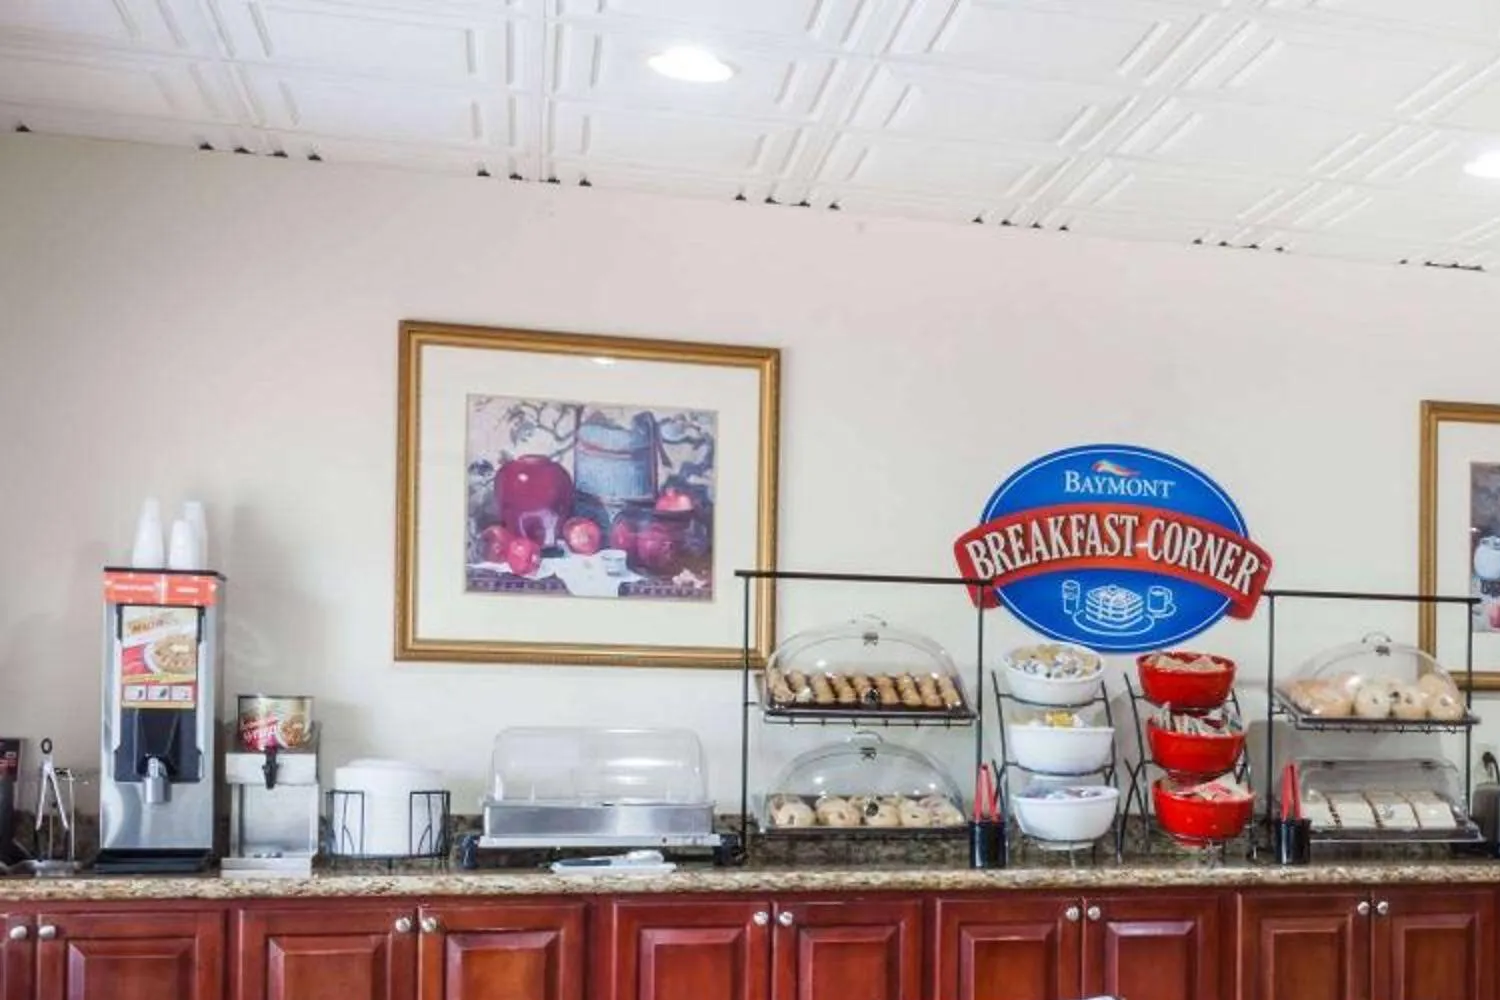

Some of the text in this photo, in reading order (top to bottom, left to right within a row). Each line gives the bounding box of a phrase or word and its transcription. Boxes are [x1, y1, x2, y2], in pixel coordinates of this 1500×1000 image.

[1064, 470, 1174, 497] BAYMONT
[965, 513, 1259, 596] BREAKFAST CORNER
